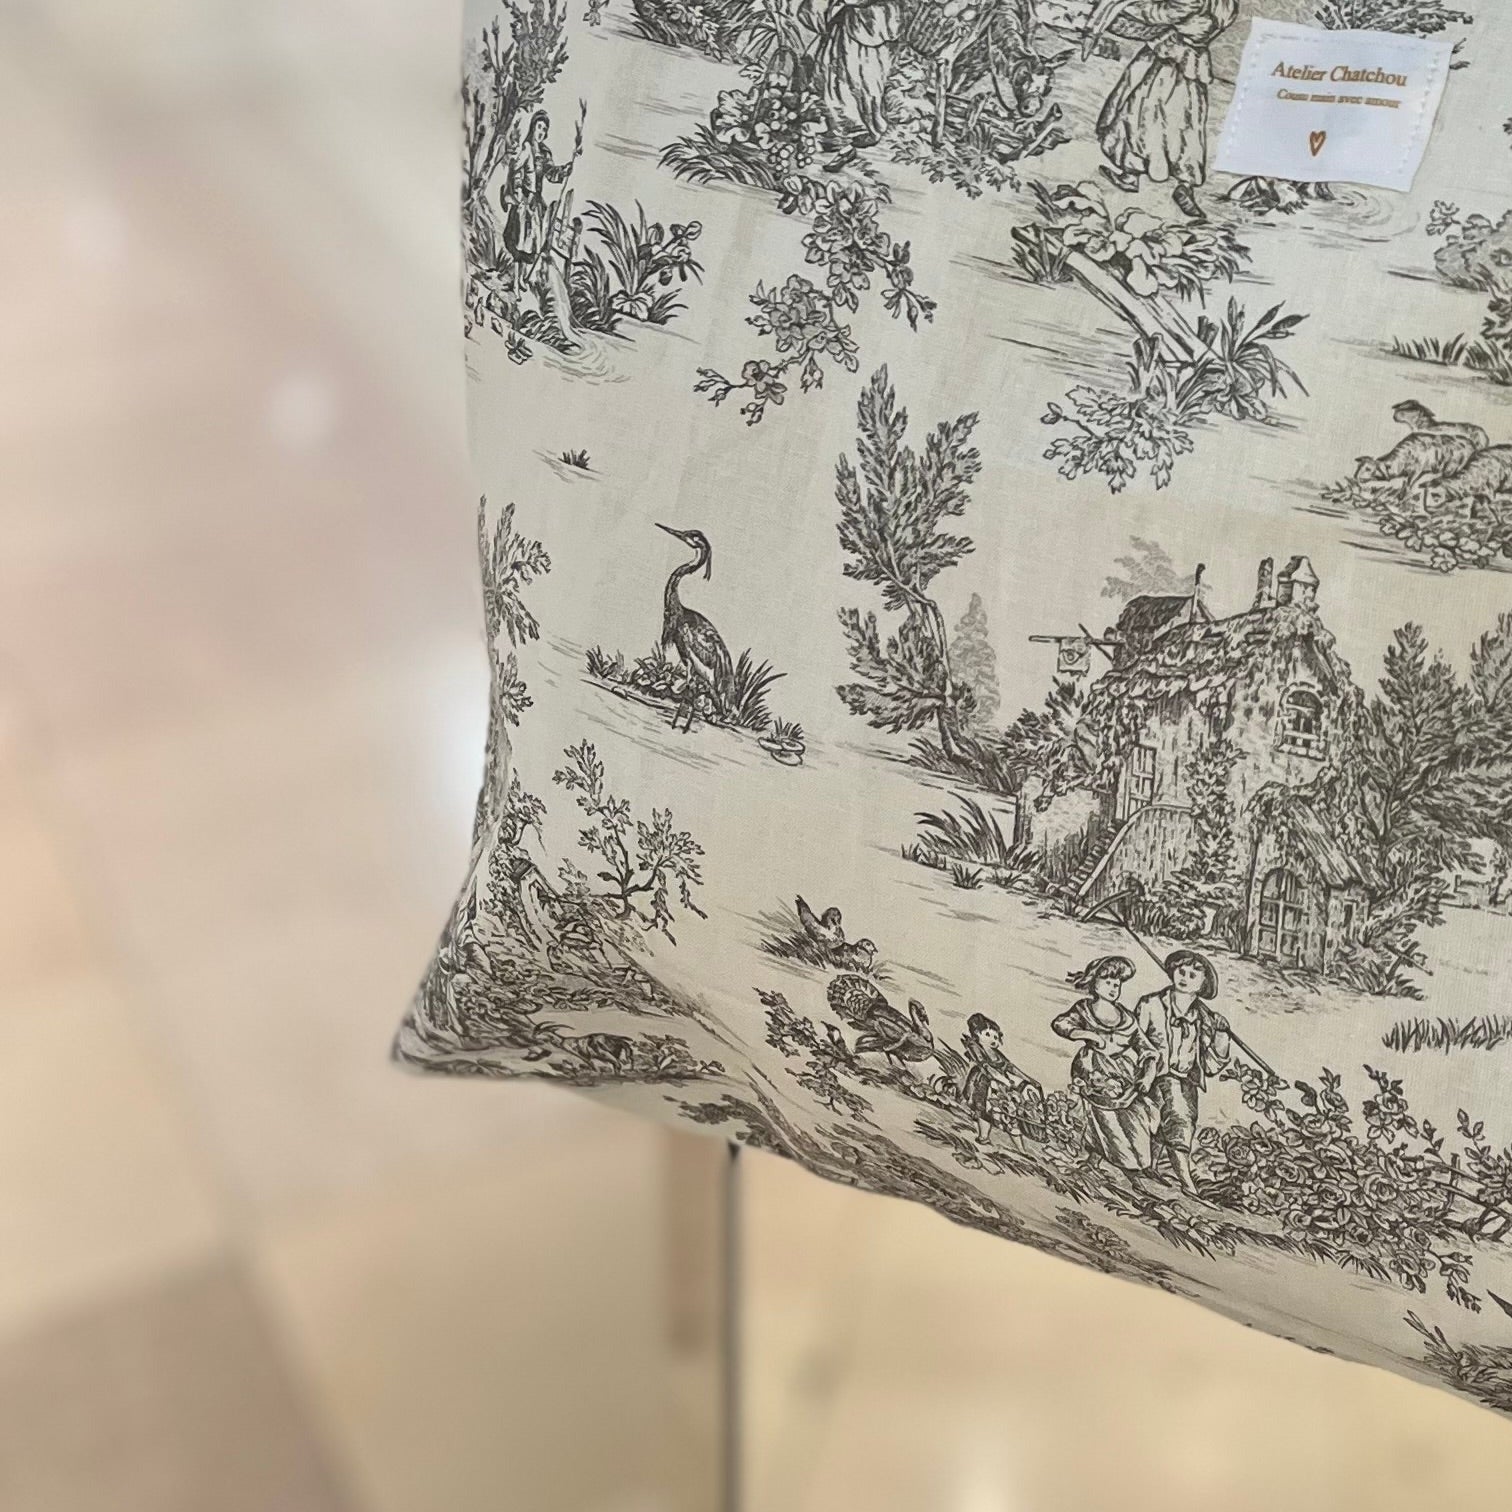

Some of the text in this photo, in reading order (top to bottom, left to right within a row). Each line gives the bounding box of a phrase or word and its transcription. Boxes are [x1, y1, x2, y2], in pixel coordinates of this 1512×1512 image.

[1271, 61, 1408, 87] Atelier Chatchou
[1338, 95, 1363, 105] avec
